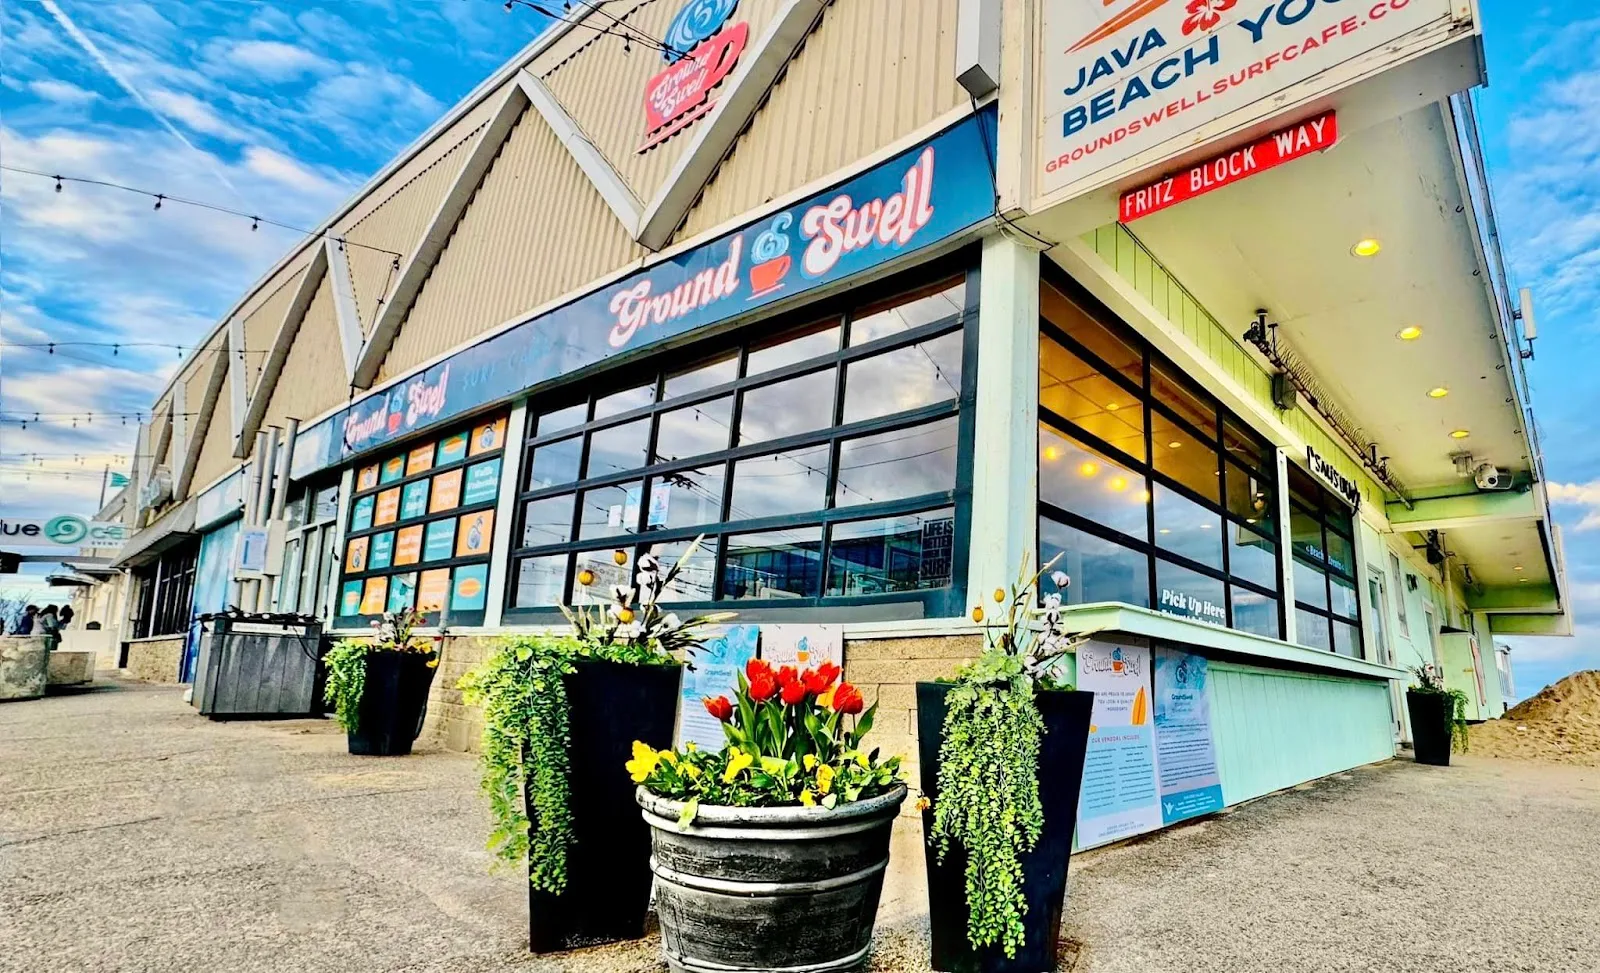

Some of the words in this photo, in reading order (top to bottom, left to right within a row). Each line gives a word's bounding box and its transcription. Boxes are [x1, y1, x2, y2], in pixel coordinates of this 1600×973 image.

[649, 44, 716, 111] Ground
[662, 67, 709, 118] Swell
[1063, 27, 1167, 95] JAVA
[1063, 35, 1219, 138] BEACH
[1237, 0, 1341, 43] YO
[1125, 178, 1174, 217] FRITZ
[1190, 145, 1256, 192] BLOCK
[1274, 116, 1326, 158] WAY
[607, 233, 744, 348] Ground
[802, 146, 934, 276] Swell
[343, 391, 391, 449] Ground
[405, 361, 450, 428] Swell
[1161, 588, 1187, 609] Pick
[1188, 596, 1202, 616] Up
[1203, 600, 1226, 618] Here
